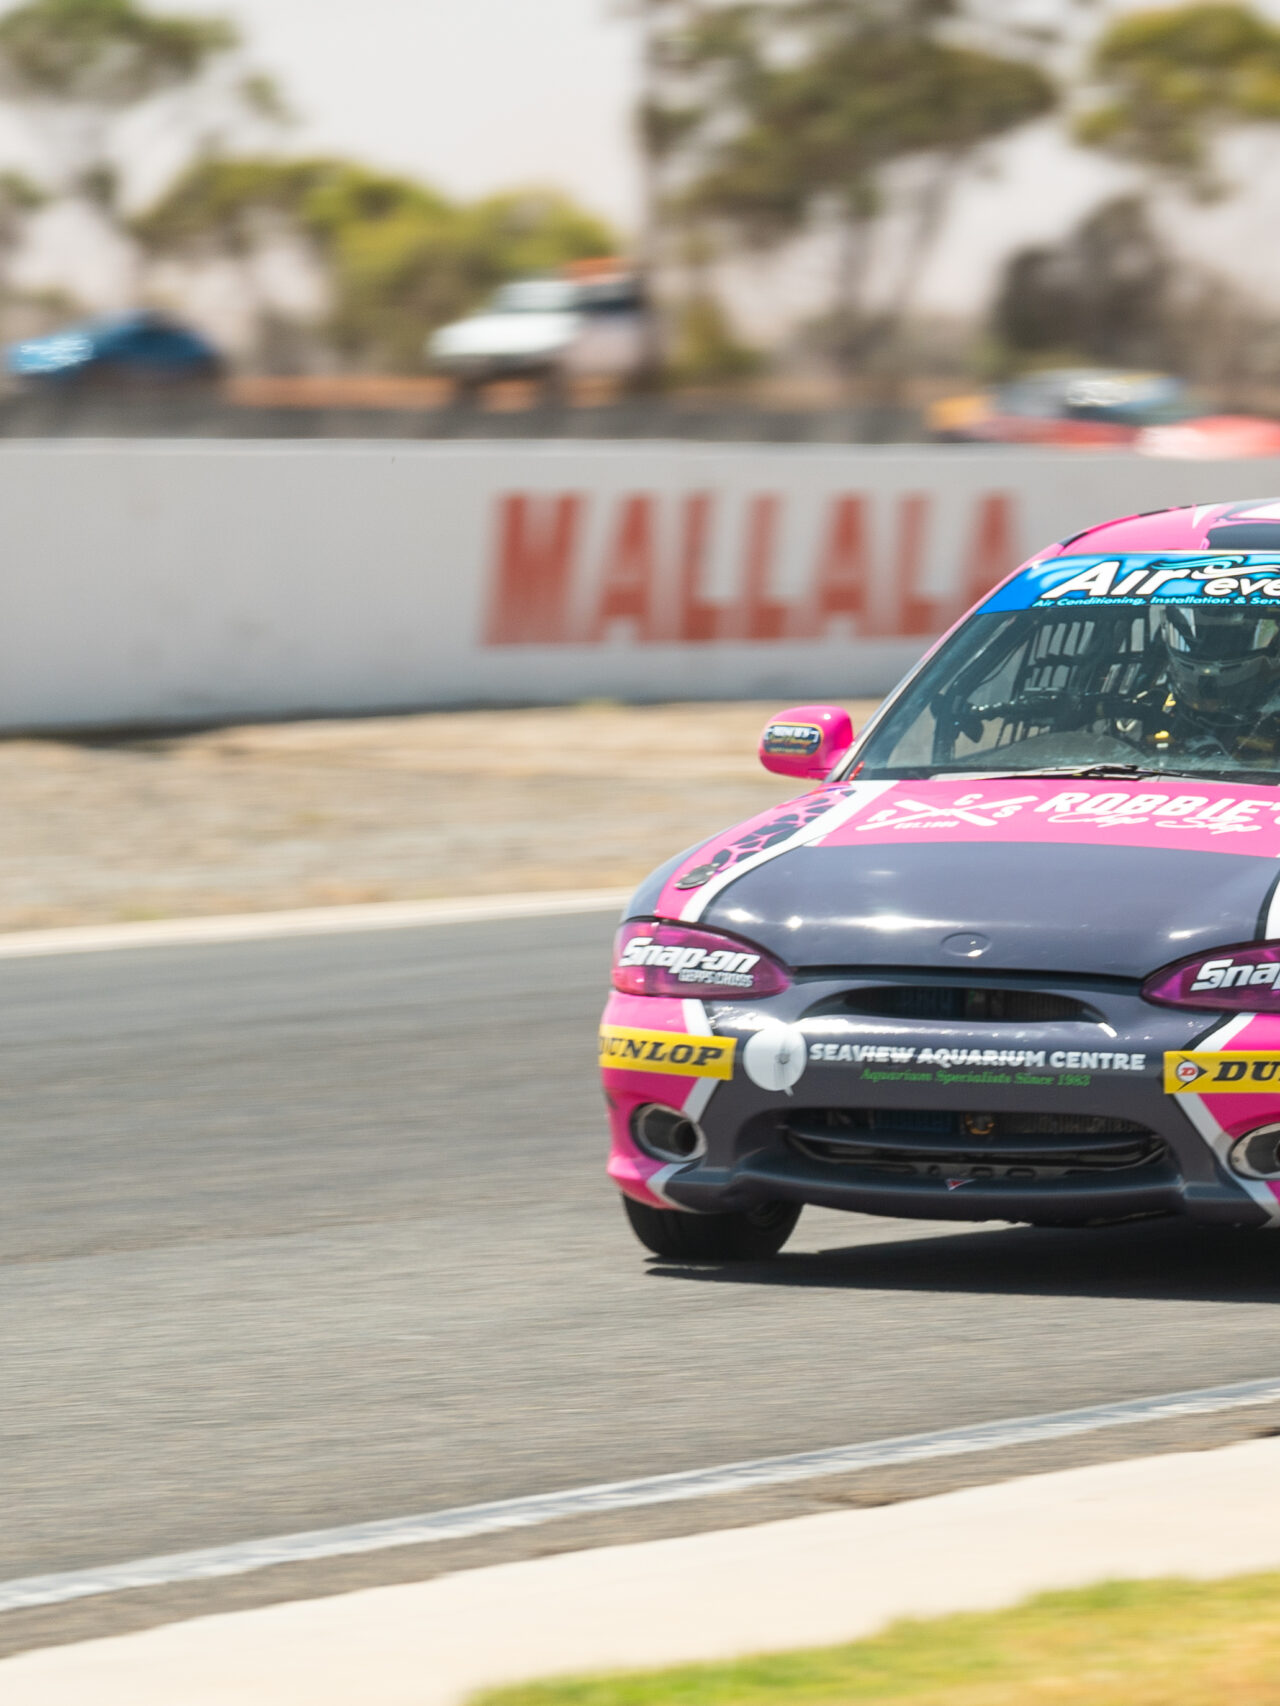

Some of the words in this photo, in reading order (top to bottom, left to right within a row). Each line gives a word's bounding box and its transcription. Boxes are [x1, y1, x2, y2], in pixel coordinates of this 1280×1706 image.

[483, 489, 1023, 647] MALLALA
[1041, 560, 1191, 599] Air
[1032, 599, 1052, 608] Air
[1151, 596, 1230, 605] Installation
[1234, 597, 1246, 605] &
[618, 937, 760, 974] Snap-on
[809, 1043, 916, 1063] SEAVIEW
[916, 1047, 1046, 1068] AQUARIUM
[1050, 1051, 1146, 1071] CENTRE
[860, 1068, 932, 1083] Aquarium
[936, 1070, 1011, 1086] Specialists
[1014, 1072, 1054, 1086] Since
